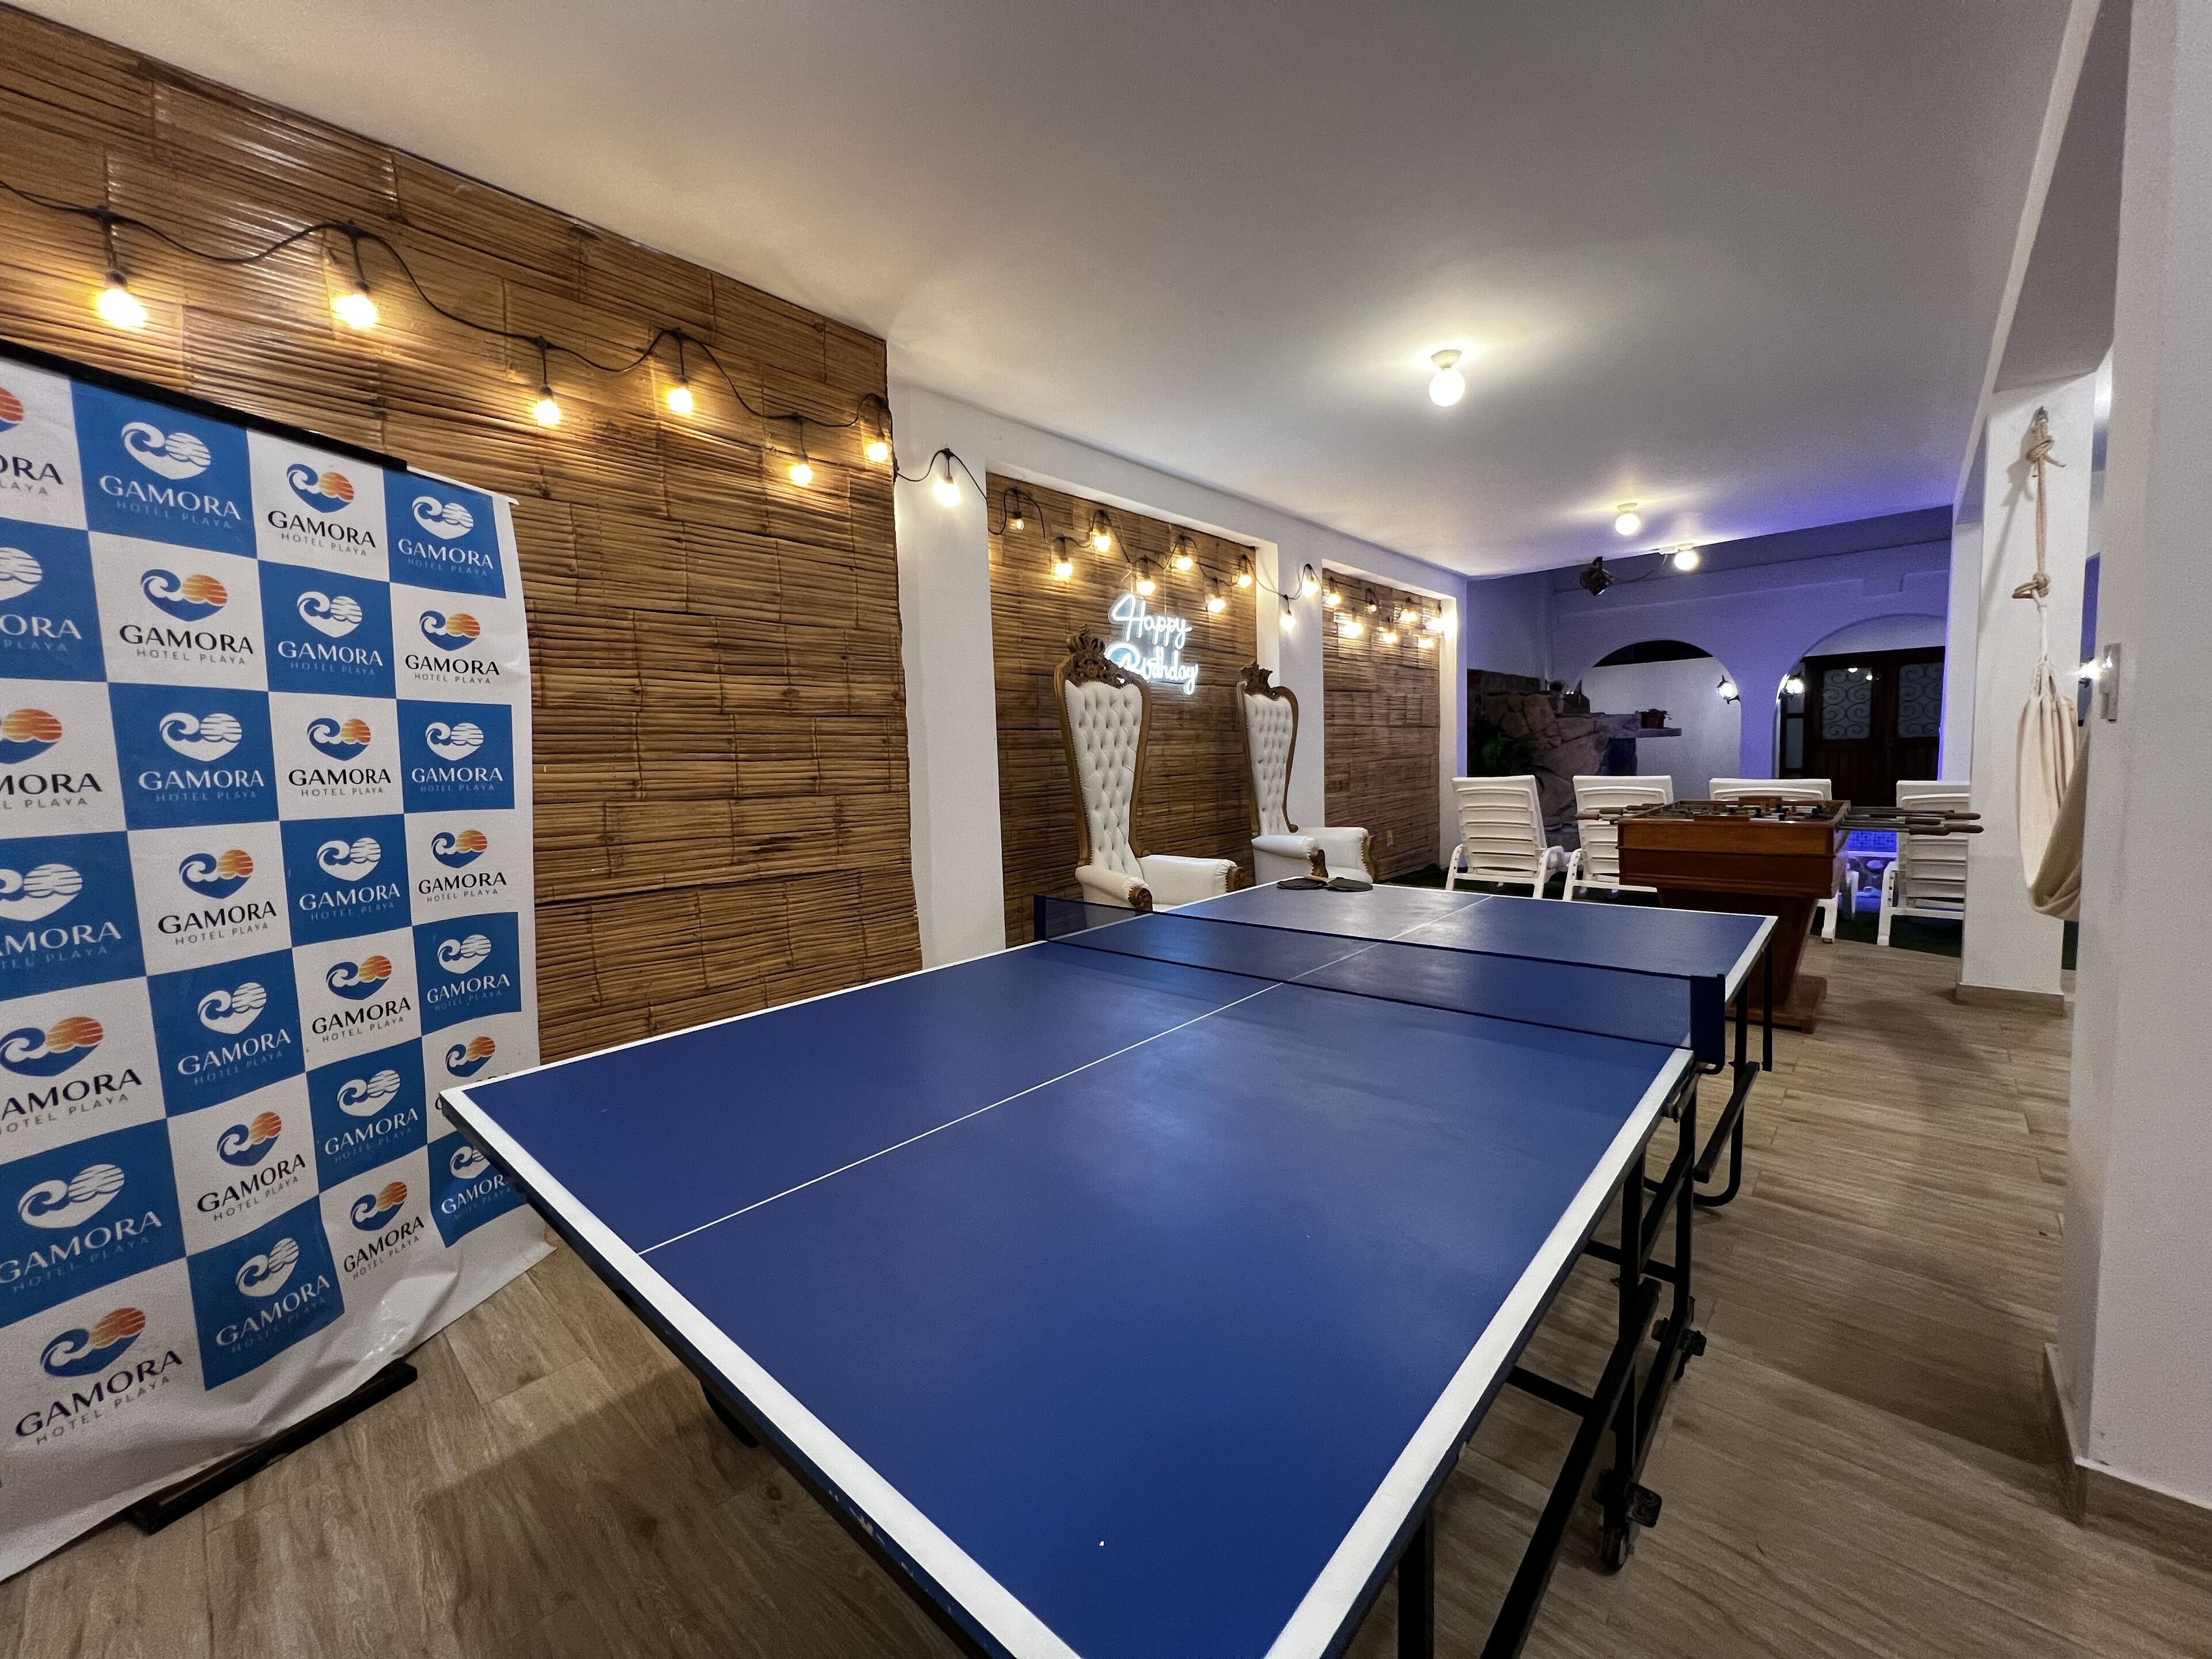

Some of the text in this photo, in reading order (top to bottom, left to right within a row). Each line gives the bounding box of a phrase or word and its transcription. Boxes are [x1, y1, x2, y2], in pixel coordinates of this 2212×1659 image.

[100, 475, 241, 520] GAMORA
[117, 501, 232, 530] HOTEL PLAYA
[268, 510, 376, 548] GAMORA
[281, 532, 367, 556] HOTEL PLAYA
[398, 539, 494, 569] GAMORA
[408, 558, 488, 577] HOTEL PLAYA
[1111, 593, 1193, 650] Happy
[3, 639, 68, 652] PLAYA
[119, 624, 254, 654] GAMORA
[137, 649, 245, 665] HOTEL PLAYA
[278, 641, 383, 666] GAMORA
[405, 654, 500, 676] GAMORA
[291, 662, 375, 676] HOTEL PLAYA
[414, 672, 491, 684] HOTEL PLAYA
[138, 770, 264, 790] GAMORA
[289, 768, 391, 786] GAMORA
[411, 767, 503, 783] GAMORA
[421, 784, 495, 793] HOTEL PLAYA
[25, 797, 88, 808] PLAYA
[156, 790, 256, 802] HOTEL PLAYA
[301, 788, 346, 797] HOTEL
[418, 872, 507, 894] GAMORA
[427, 888, 498, 903] HOTEL PLAYA
[299, 883, 400, 911] GAMORA
[158, 901, 276, 934] GAMORA
[311, 902, 395, 921] HOTEL PLAYA
[175, 922, 268, 945] HOTEL PLAYA
[427, 974, 510, 1003] GAMORA
[434, 990, 502, 1012] HOTEL PLAYA
[312, 997, 411, 1035] GAMORA
[322, 1017, 404, 1043] HOTEL PLAYA
[177, 1029, 291, 1075] GAMORA
[194, 1051, 282, 1086] HOTEL PLAYA
[69, 1093, 128, 1115] PLAYA
[324, 1108, 419, 1156] GAMORA
[196, 1153, 306, 1213] GAMORA
[441, 1174, 508, 1214] GAMOR
[213, 1176, 299, 1222] HOTEL PLAYA
[0, 1211, 162, 1284] GAMORA
[343, 1215, 425, 1273] GAMORA
[353, 1234, 419, 1280] HOTEL PLAYA
[215, 1274, 330, 1347] GAMORA
[15, 1350, 183, 1437] GAMORA
[36, 1376, 170, 1445] HOTEL PLAYA
